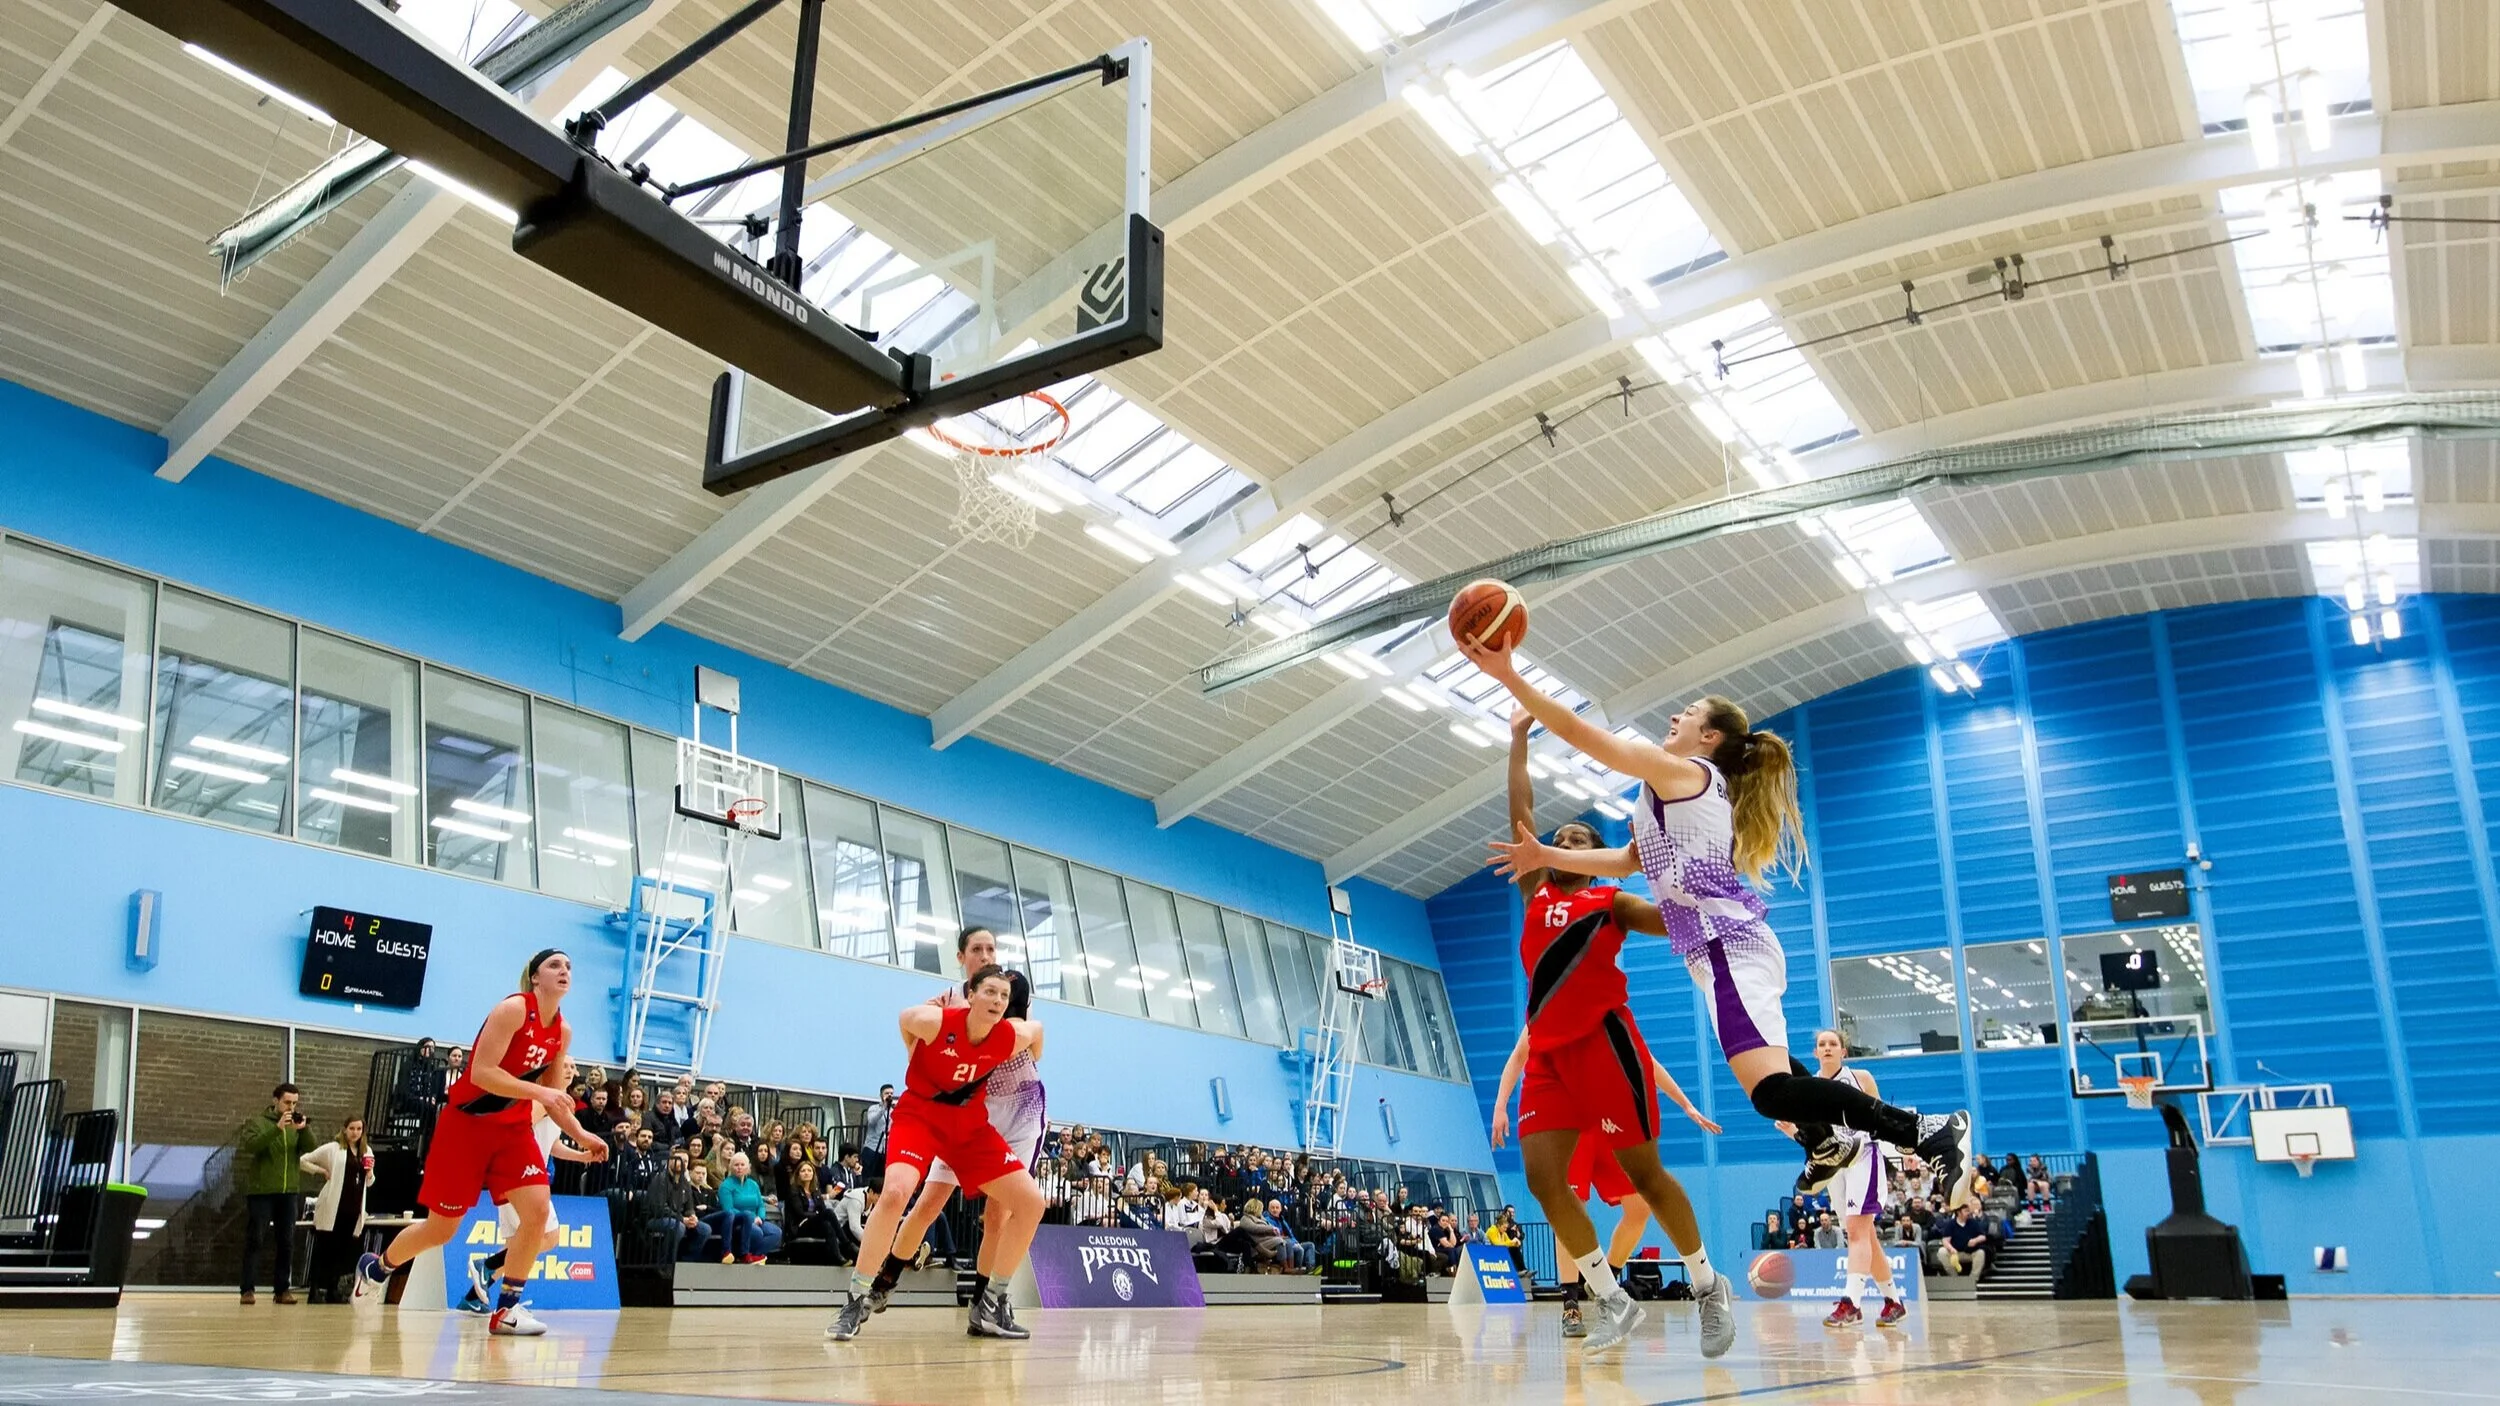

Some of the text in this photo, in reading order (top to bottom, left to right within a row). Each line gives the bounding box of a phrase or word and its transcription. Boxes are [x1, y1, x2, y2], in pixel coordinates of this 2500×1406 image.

[732, 262, 808, 324] MONDO
[2110, 880, 2185, 895] HOME GUESTS
[1545, 901, 1572, 928] 15
[343, 915, 380, 935] 4 2
[315, 929, 427, 960] HOME GUESTS
[320, 973, 332, 990] 0
[522, 1044, 548, 1070] 23
[952, 1063, 978, 1083] 21
[1088, 1235, 1138, 1247] CALEDONIA
[1078, 1246, 1159, 1285] PRIDE
[1478, 1258, 1511, 1273] Arnold
